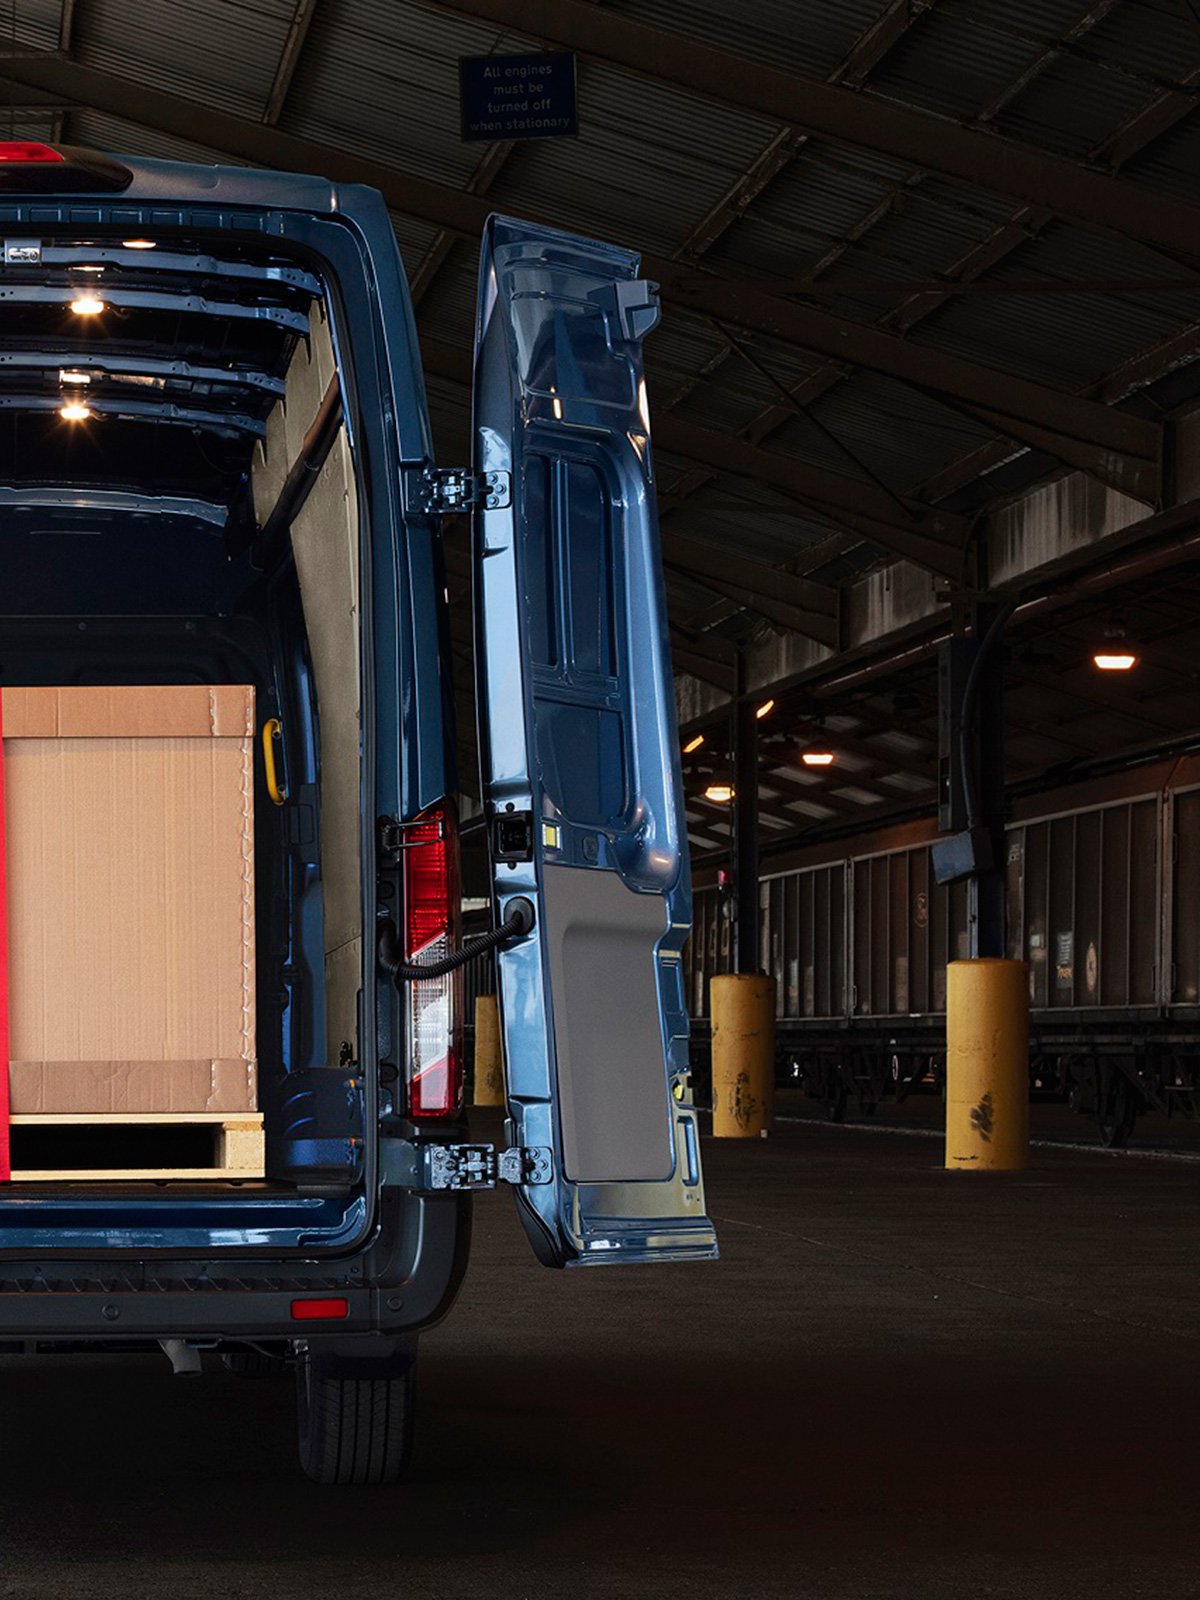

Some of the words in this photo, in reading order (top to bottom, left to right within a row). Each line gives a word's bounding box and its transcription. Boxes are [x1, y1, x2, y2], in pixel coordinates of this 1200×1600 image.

[483, 67, 501, 78] All
[505, 65, 553, 78] engines
[494, 84, 524, 95] must
[528, 82, 544, 93] be
[487, 100, 528, 113] turned
[533, 98, 551, 111] off
[470, 121, 502, 132] when
[506, 117, 570, 130] stationary
